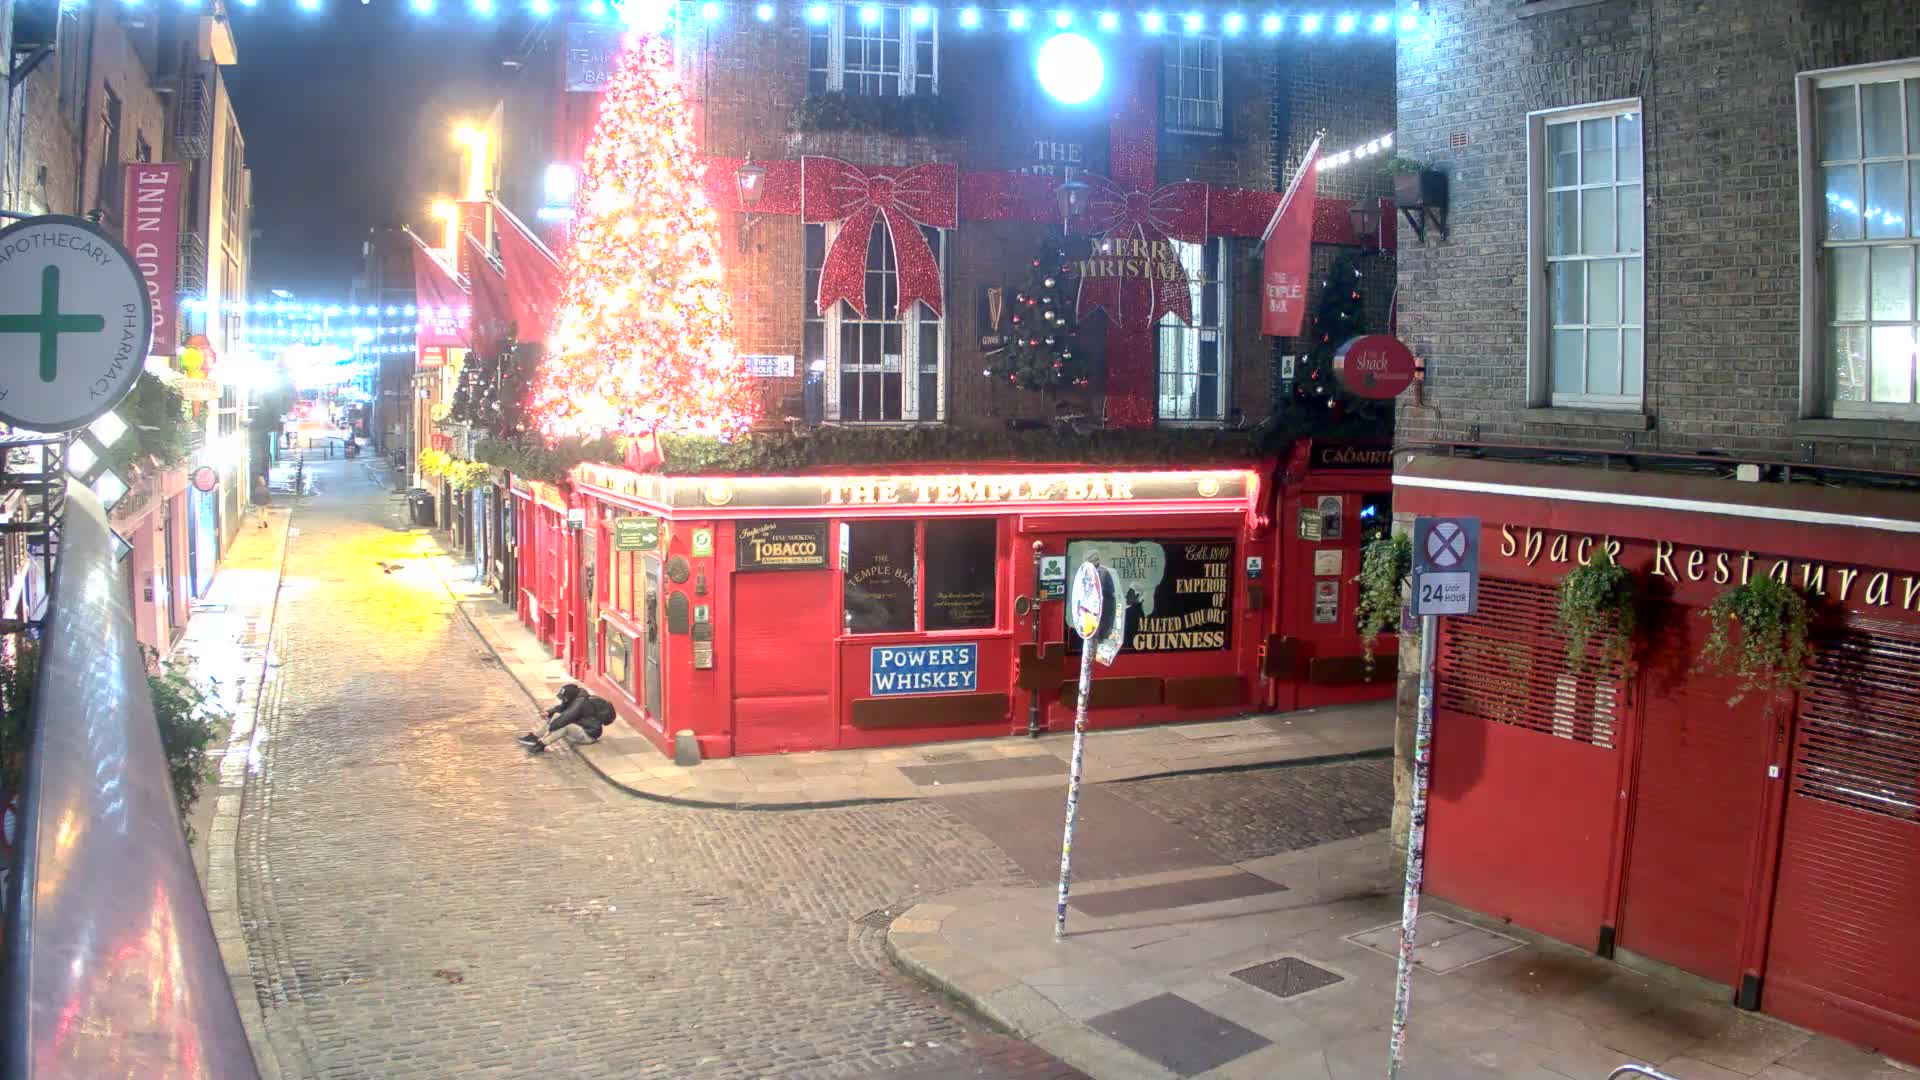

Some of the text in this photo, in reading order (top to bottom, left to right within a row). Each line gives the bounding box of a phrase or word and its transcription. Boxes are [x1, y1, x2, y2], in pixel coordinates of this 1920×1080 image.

[1034, 140, 1080, 162] THE
[137, 171, 168, 232] NINE
[1091, 238, 1182, 262] MERRY
[89, 304, 136, 400] PHARMACY
[826, 475, 1134, 504] THE TEMPLE BAR
[750, 538, 817, 562] TOBACCO
[1124, 546, 1146, 558] THE
[1112, 558, 1157, 569] TEMPLE
[1122, 568, 1146, 579] BAR
[1203, 563, 1227, 578] THE
[848, 566, 915, 588] TEMPLE BAR
[1176, 578, 1227, 594] EMPEROR
[1212, 593, 1225, 608] OF
[1422, 583, 1444, 603] 24
[1445, 593, 1466, 602] HOUR
[1138, 608, 1227, 632] MALTED LIQUORS
[1132, 631, 1225, 651] GUINNESS
[879, 648, 969, 668] POWER'S
[874, 670, 975, 691] WHISKEY
